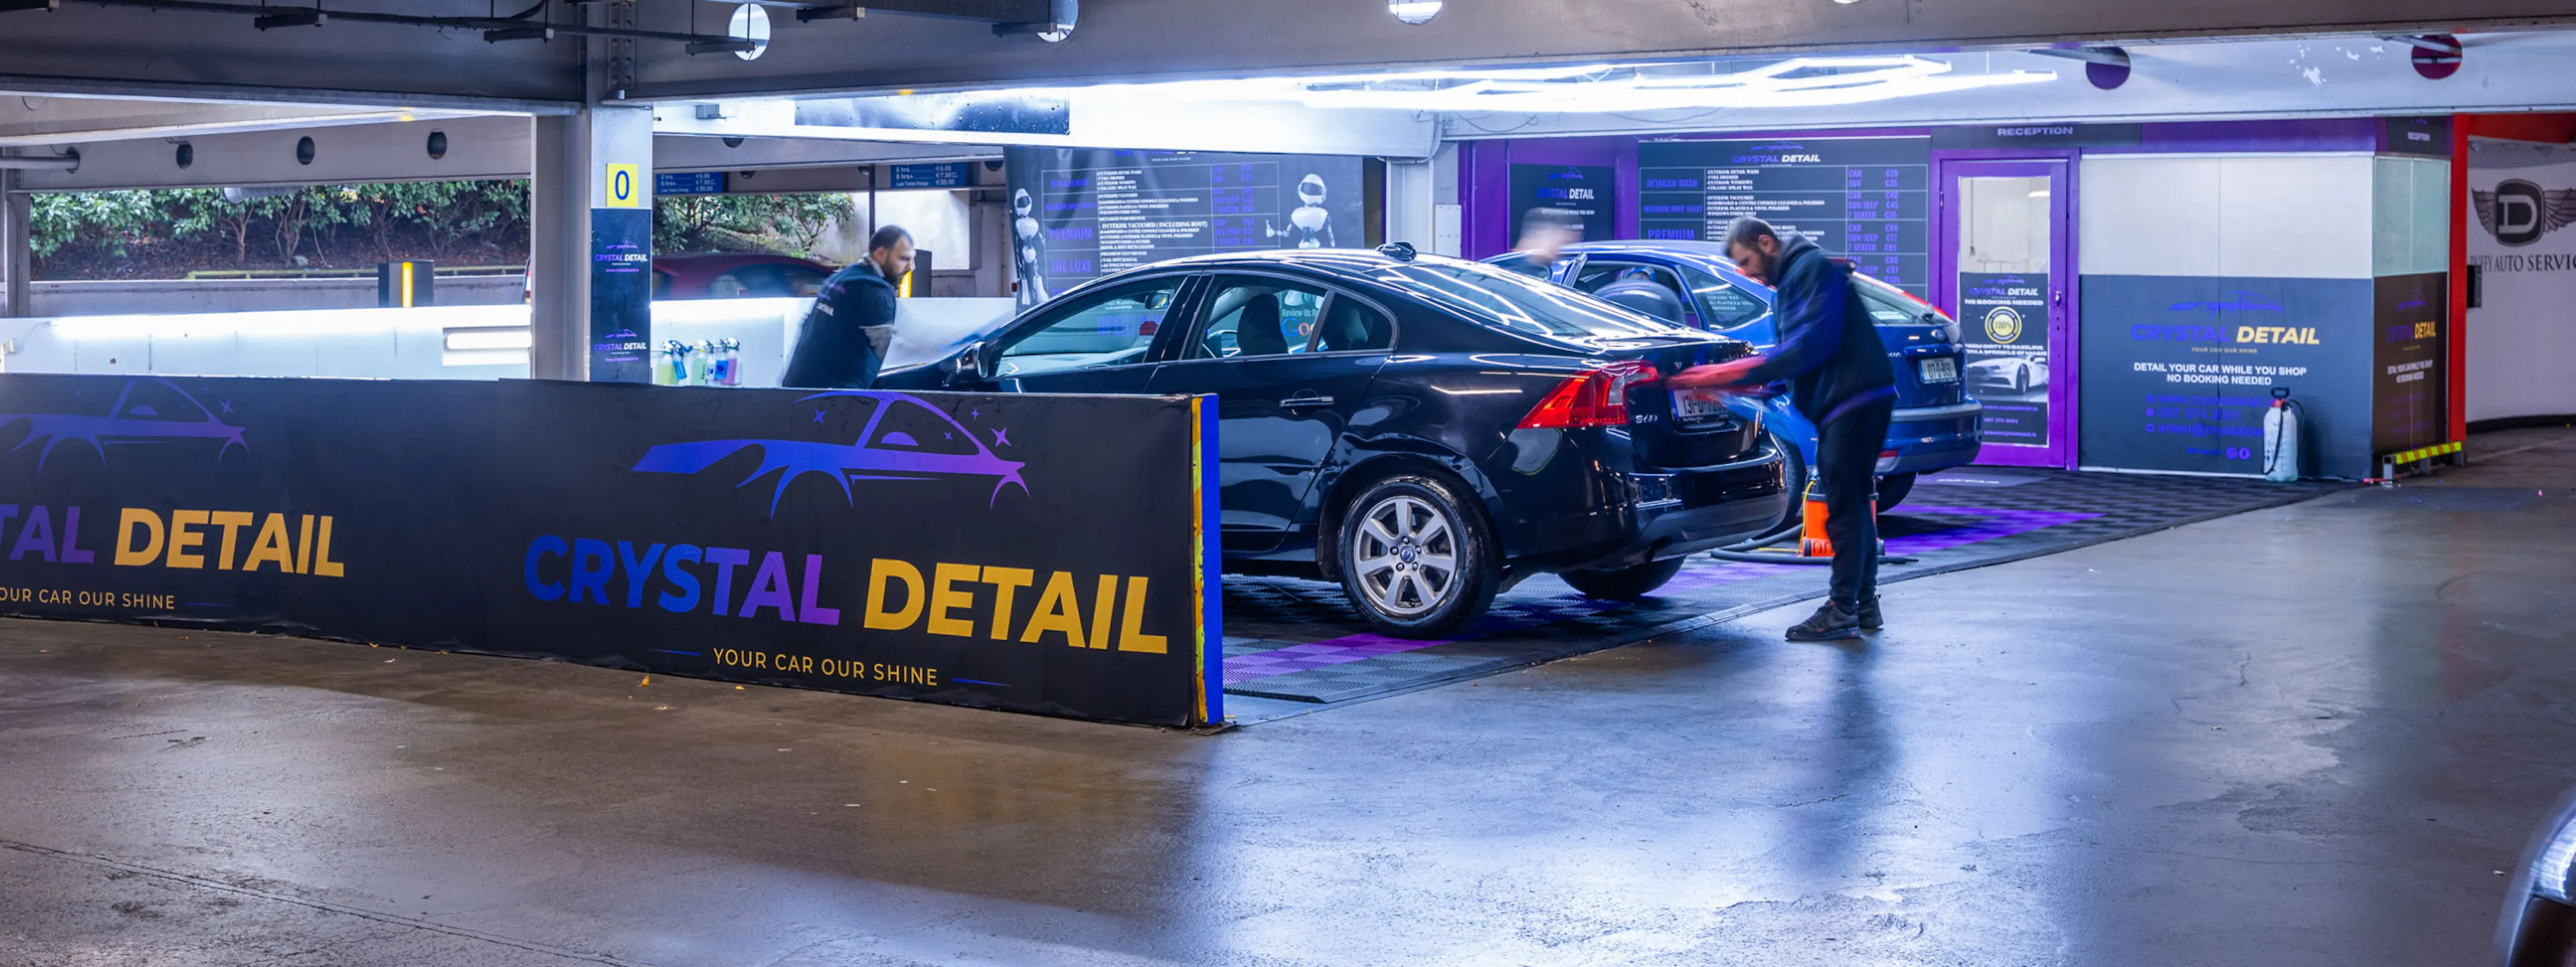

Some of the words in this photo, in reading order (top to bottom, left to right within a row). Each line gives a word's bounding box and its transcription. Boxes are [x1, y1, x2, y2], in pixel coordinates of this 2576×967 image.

[1998, 127, 2073, 136] RECEPTION
[1732, 155, 1779, 163] CRYSTAL
[1781, 154, 1821, 162] DETAIL
[1536, 188, 1568, 199] CRYSTAL
[1569, 188, 1595, 199] DETAIL
[2498, 194, 2538, 234] D
[1049, 227, 1093, 240] PREMIUM
[1847, 223, 1862, 232] CAR
[1648, 229, 1695, 241] PREMIUM
[624, 254, 648, 262] DETAIL
[2496, 255, 2524, 272] AUTO
[1051, 260, 1067, 273] THE
[1069, 259, 1093, 272] LUXE
[1970, 287, 2007, 295] CRYSTAL
[2008, 288, 2039, 296] DETAIL
[1995, 321, 2012, 329] 100%
[2387, 325, 2414, 343] CRYSTAL
[2414, 321, 2436, 340] DETAIL
[2131, 323, 2231, 343] CRYSTAL
[2237, 325, 2320, 345] DETAIL
[2134, 362, 2167, 372] DETAIL
[2169, 363, 2197, 373] YOUR
[2198, 364, 2220, 374] CAR
[2222, 364, 2253, 374] WHILE
[2255, 366, 2276, 375] YOU
[2278, 366, 2307, 376] SHOP
[2167, 372, 2182, 383] NO
[2184, 374, 2229, 385] BOOKING
[2231, 374, 2272, 386] NEEDED
[2157, 407, 2180, 419] 087
[2184, 408, 2206, 420] 374
[2210, 409, 2241, 421] 2001
[114, 507, 345, 578] DETAIL
[38, 589, 72, 605] CAR
[79, 591, 115, 607] OUR
[122, 592, 175, 610] SHINE
[523, 534, 841, 626] CRYSTAL
[863, 558, 1168, 654] DETAIL
[713, 647, 766, 669] YOUR
[775, 654, 813, 674] CAR
[821, 658, 865, 679] OUR
[873, 663, 938, 686] SHINE
